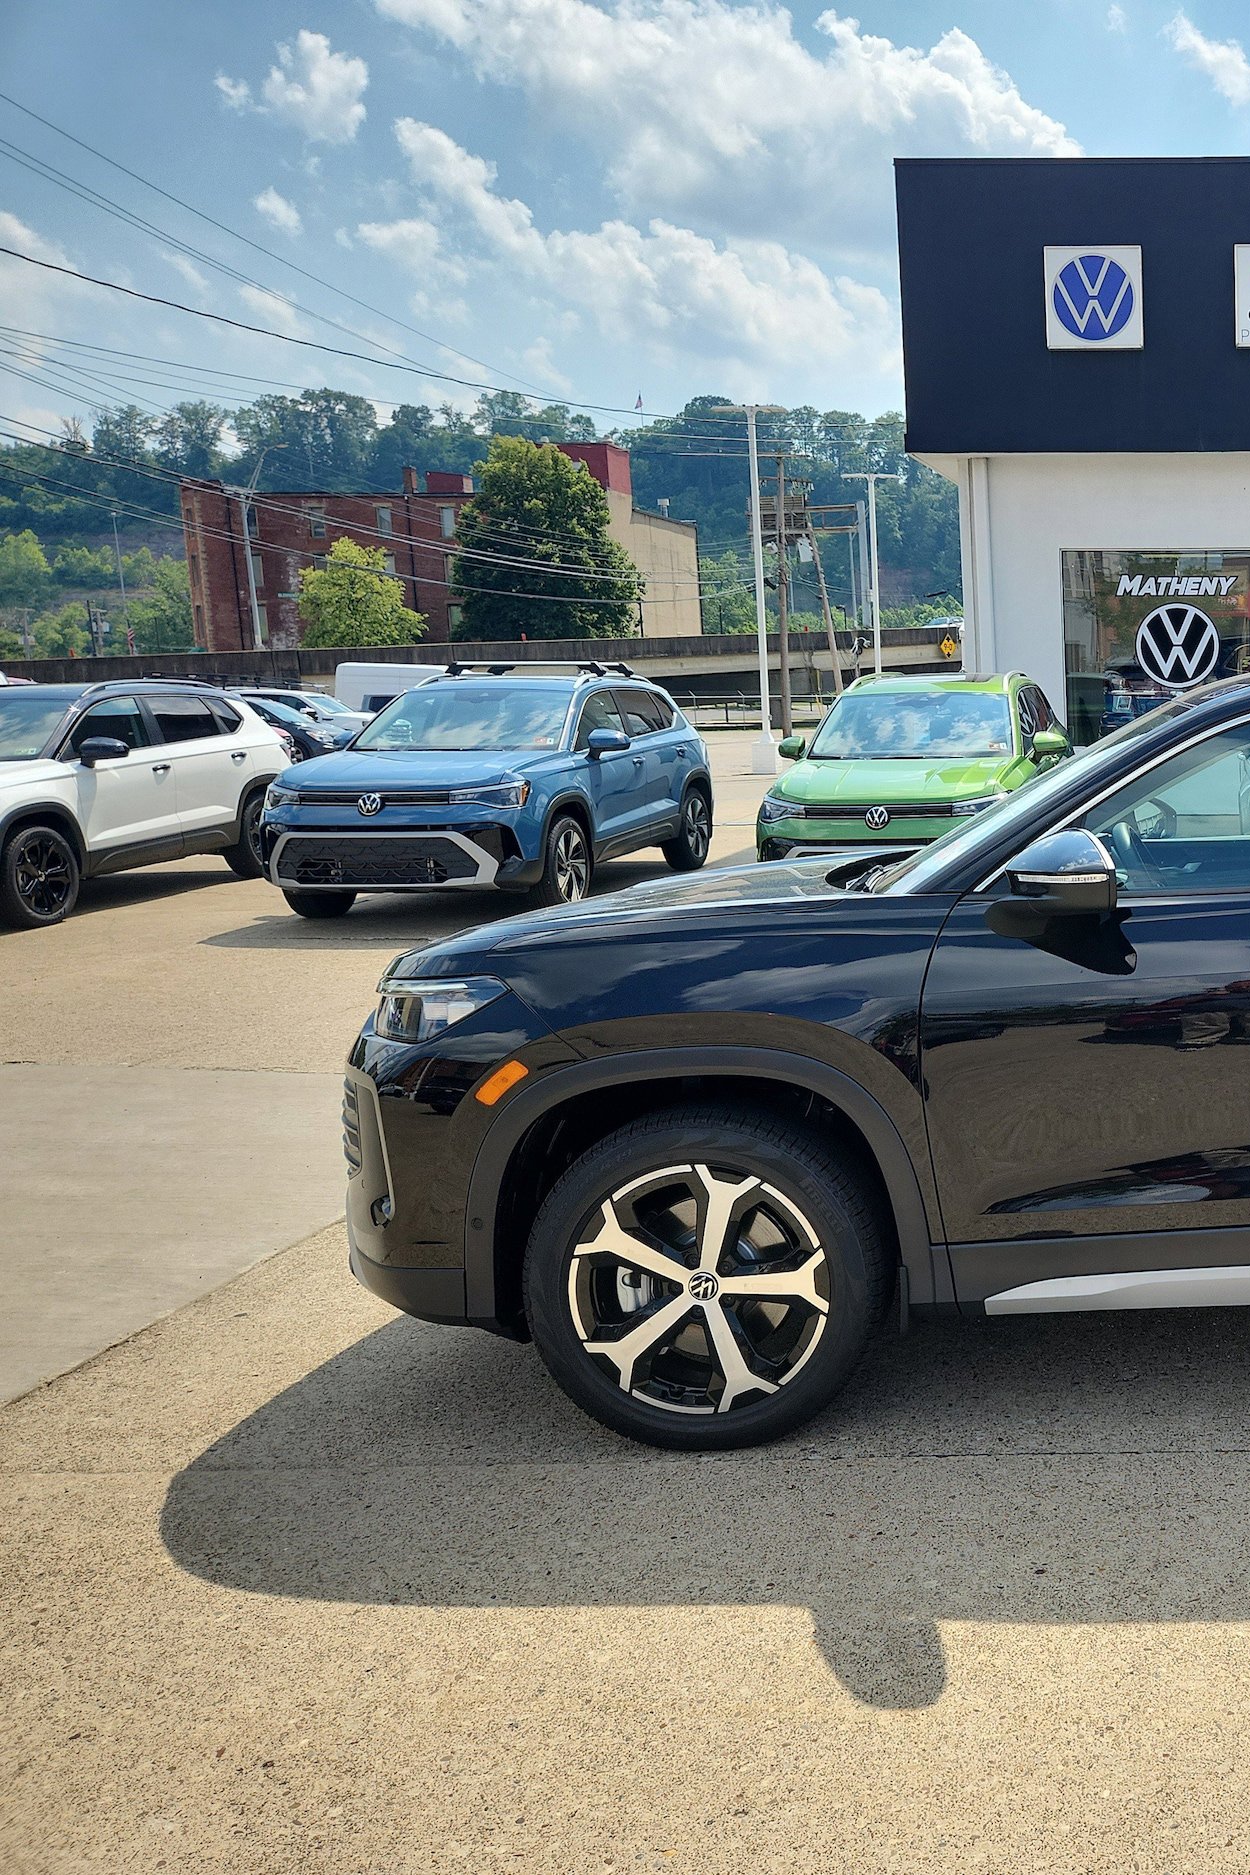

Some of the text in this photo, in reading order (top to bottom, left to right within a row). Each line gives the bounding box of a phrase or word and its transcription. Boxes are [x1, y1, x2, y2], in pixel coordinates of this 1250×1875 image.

[1053, 254, 1134, 342] VW
[1116, 574, 1238, 597] MATHENY
[1136, 603, 1220, 688] VW
